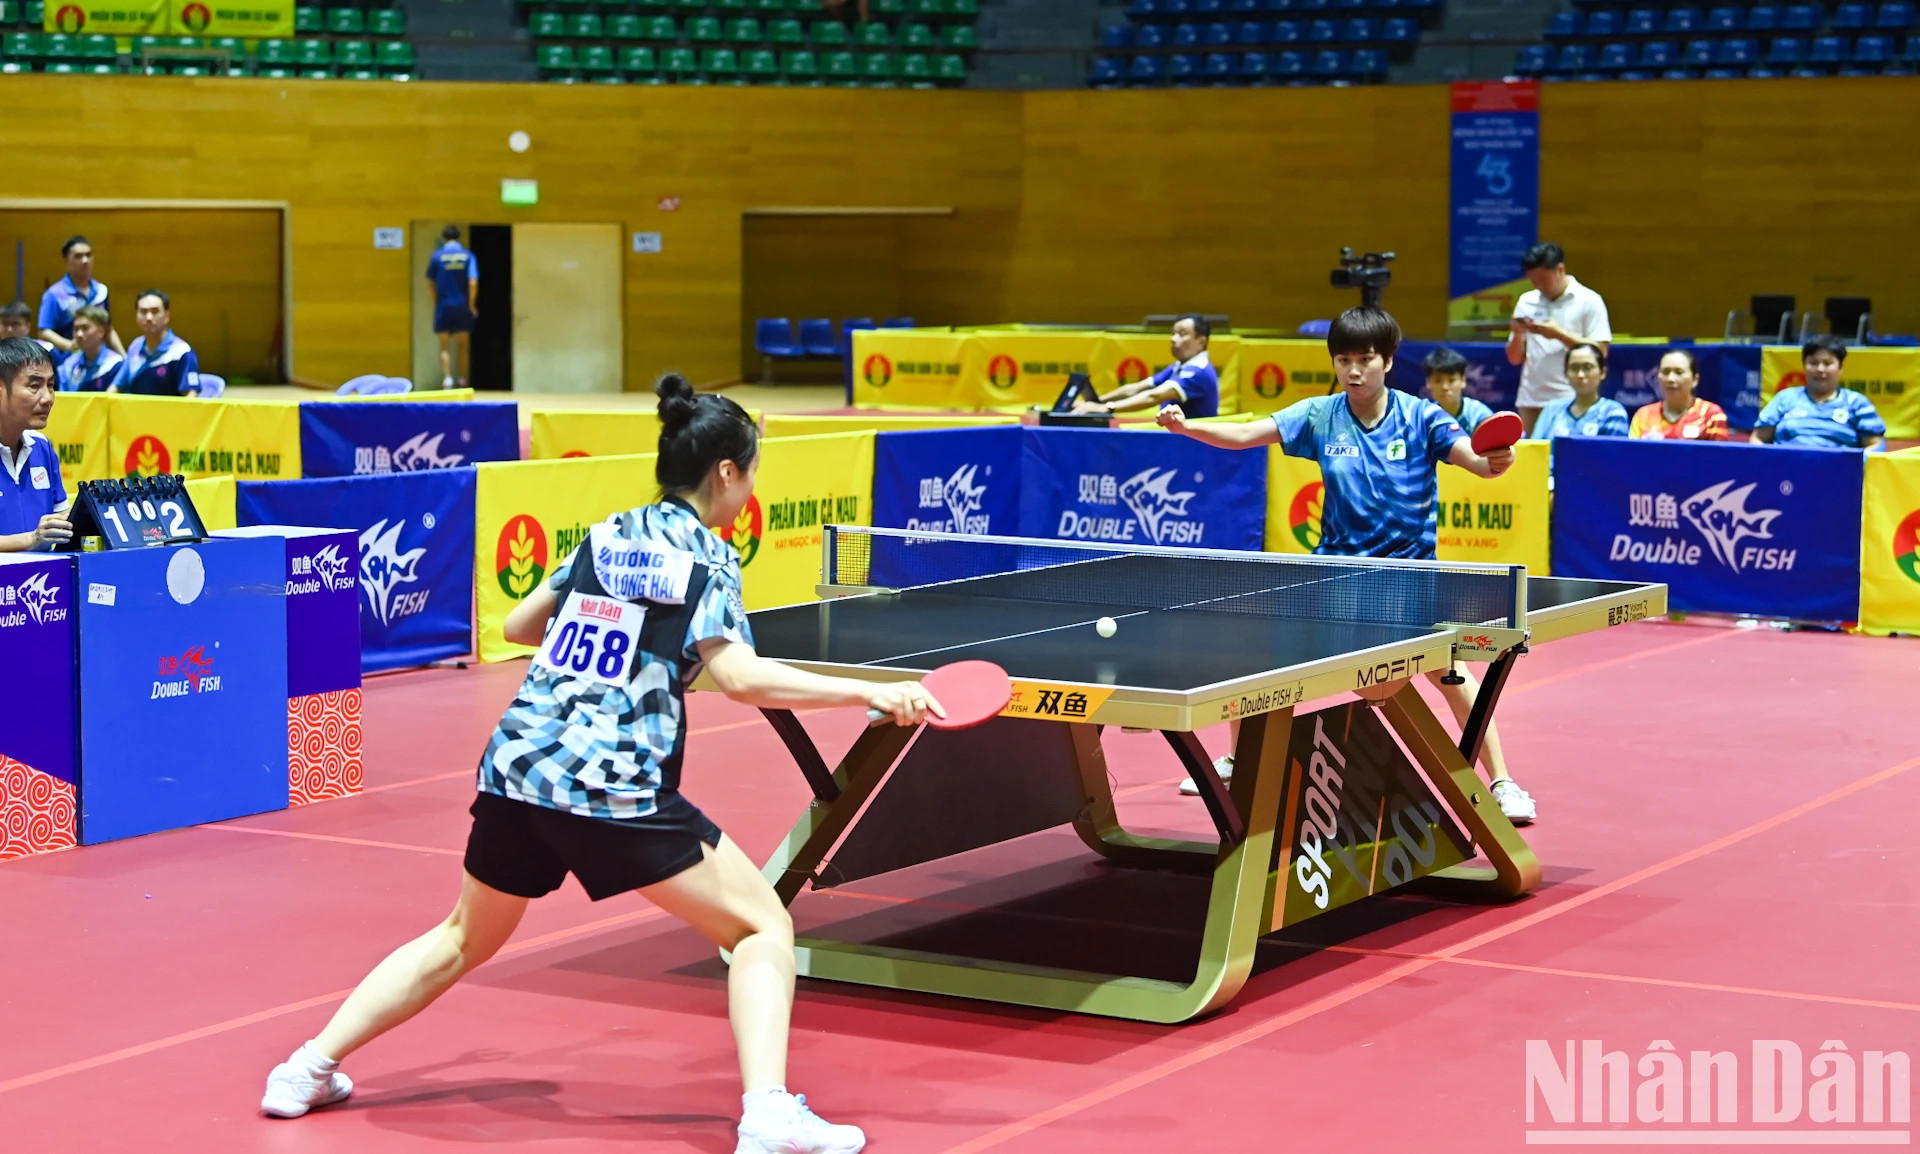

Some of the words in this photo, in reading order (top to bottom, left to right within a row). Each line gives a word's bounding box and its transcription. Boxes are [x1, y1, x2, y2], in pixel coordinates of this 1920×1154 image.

[256, 452, 281, 475] MAU
[103, 505, 129, 543] 1
[160, 501, 193, 537] 2
[1057, 511, 1137, 541] DOUBLE
[1159, 521, 1205, 544] FISH
[1452, 497, 1473, 529] CÀ
[1478, 503, 1513, 530] MAU
[1609, 534, 1701, 565] Double
[1740, 547, 1796, 571] FISH
[286, 578, 321, 596] Double
[334, 577, 355, 591] FISH
[0, 611, 27, 628] uble
[43, 608, 67, 623] FISH
[389, 589, 430, 620] FISH
[548, 621, 630, 680] 058
[1356, 654, 1425, 689] MOFIT
[150, 680, 189, 700] DOUBLE
[198, 675, 221, 693] FISH
[1240, 692, 1271, 716] Double
[1271, 687, 1292, 708] FISH
[1010, 704, 1029, 713] FISH
[1034, 689, 1088, 718] 双鱼
[1296, 713, 1347, 910] SPORT
